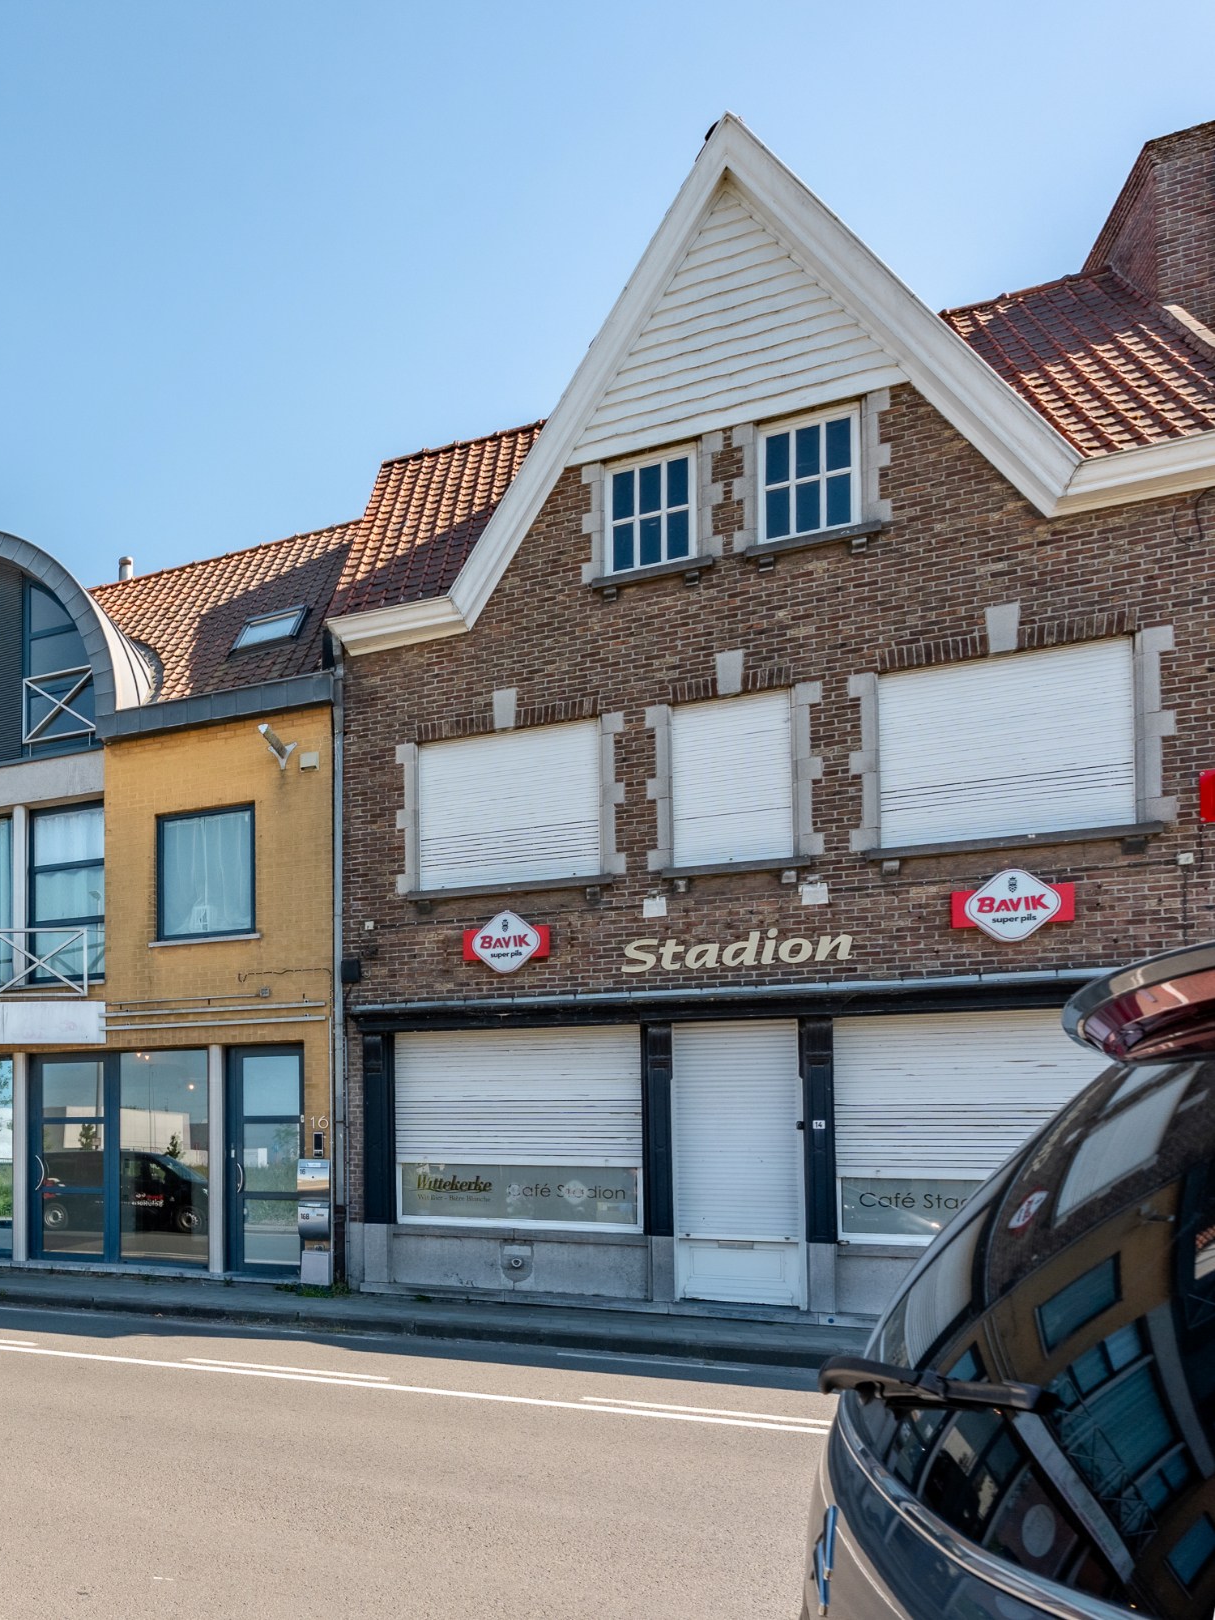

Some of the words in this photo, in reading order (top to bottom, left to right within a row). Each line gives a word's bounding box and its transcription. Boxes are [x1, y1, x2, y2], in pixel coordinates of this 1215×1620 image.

[976, 893, 1050, 914] BAVIK
[991, 916, 1018, 925] super
[1020, 913, 1037, 923] pils
[479, 933, 532, 950] BAVIK
[621, 927, 853, 973] Stadion
[510, 949, 523, 958] pils
[310, 1115, 329, 1129] 16
[416, 1174, 493, 1193] Wittekerke
[556, 1184, 626, 1200] Stadion
[859, 1192, 916, 1209] Café
